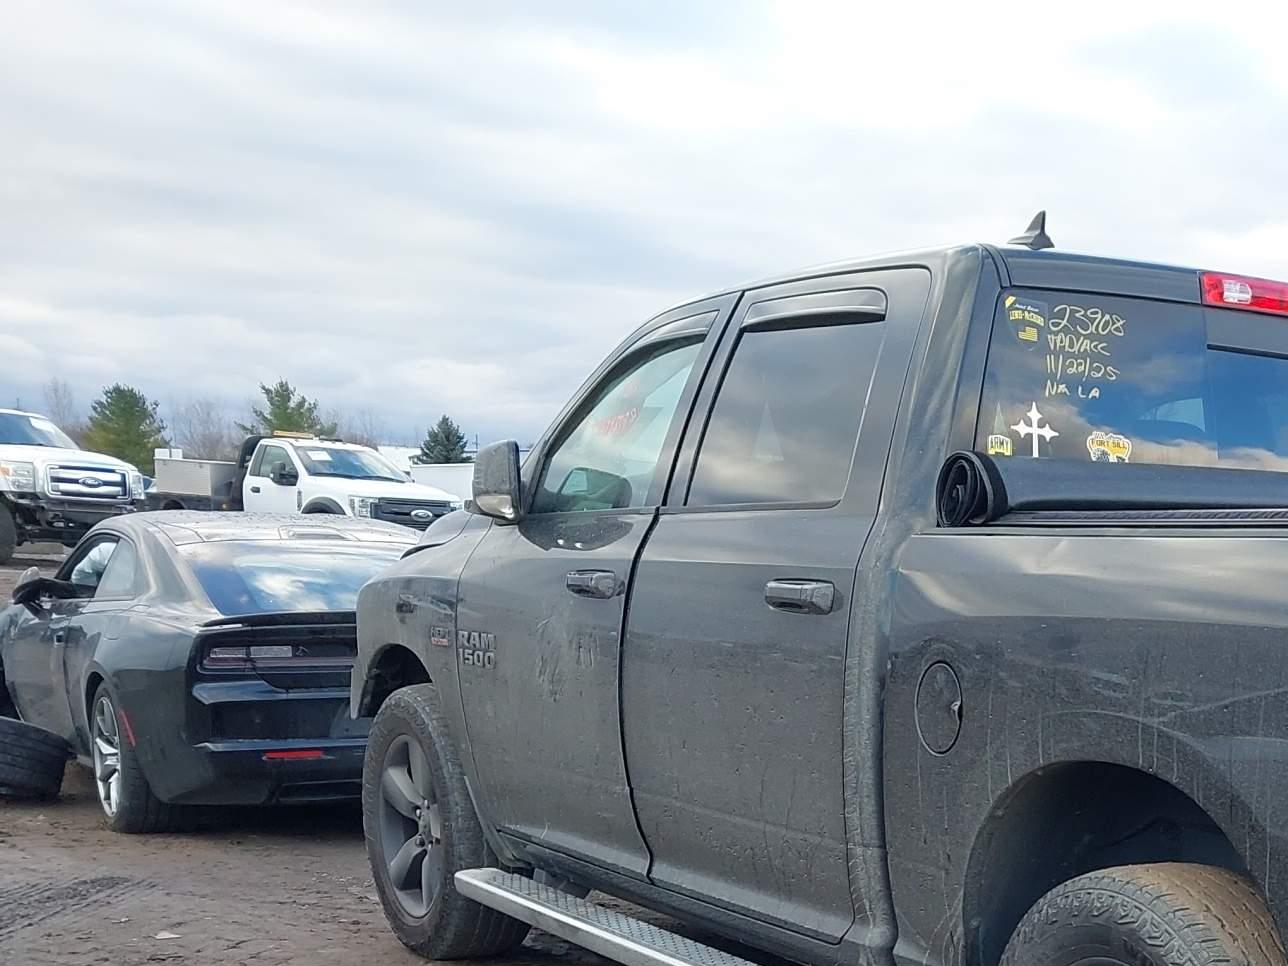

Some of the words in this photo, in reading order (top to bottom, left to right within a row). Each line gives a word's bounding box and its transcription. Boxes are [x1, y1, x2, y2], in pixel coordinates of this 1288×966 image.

[1048, 304, 1126, 336] 23908
[1046, 354, 1121, 382] 11/22/25
[458, 630, 496, 650] RAM
[458, 648, 496, 670] 1500
